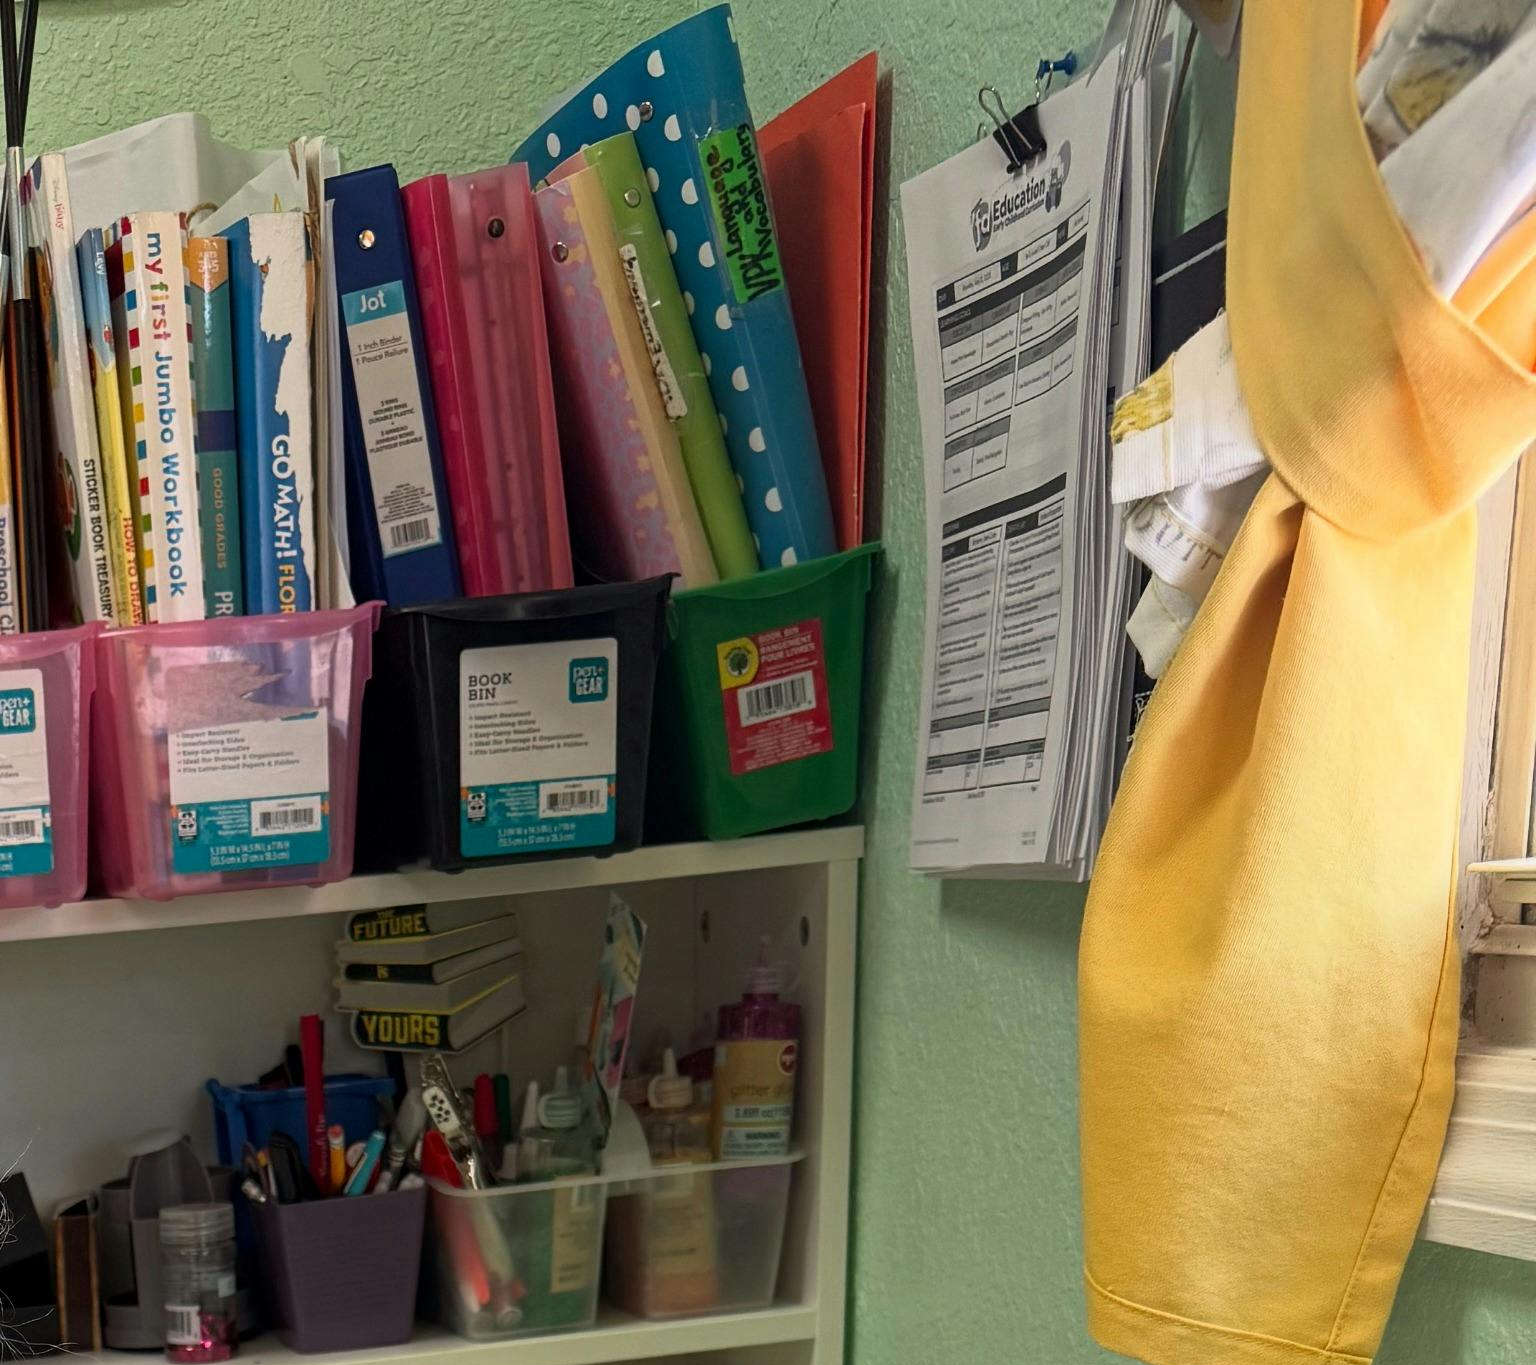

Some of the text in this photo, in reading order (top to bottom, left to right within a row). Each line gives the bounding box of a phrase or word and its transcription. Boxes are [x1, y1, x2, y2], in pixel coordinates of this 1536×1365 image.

[706, 145, 743, 258] Language
[728, 180, 754, 225] and
[735, 123, 781, 304] VPK Vocabulary
[993, 176, 1045, 222] Education
[94, 250, 106, 275] Levy
[359, 291, 386, 313] Jot
[145, 232, 188, 598] my first Jumbo Workbook
[83, 458, 114, 619] STICKER BOOK TREASURY
[122, 517, 137, 553] HOW
[271, 434, 298, 613] GO MATH! FLOR
[211, 467, 235, 616] GOOD GRADES PR
[127, 558, 140, 577] TO
[468, 672, 512, 687] BOOK
[468, 687, 496, 701] BIN
[575, 676, 603, 696] GEAR
[2, 708, 31, 727] GEAR
[353, 913, 428, 942] FUTURE
[361, 1014, 440, 1046] YOURS
